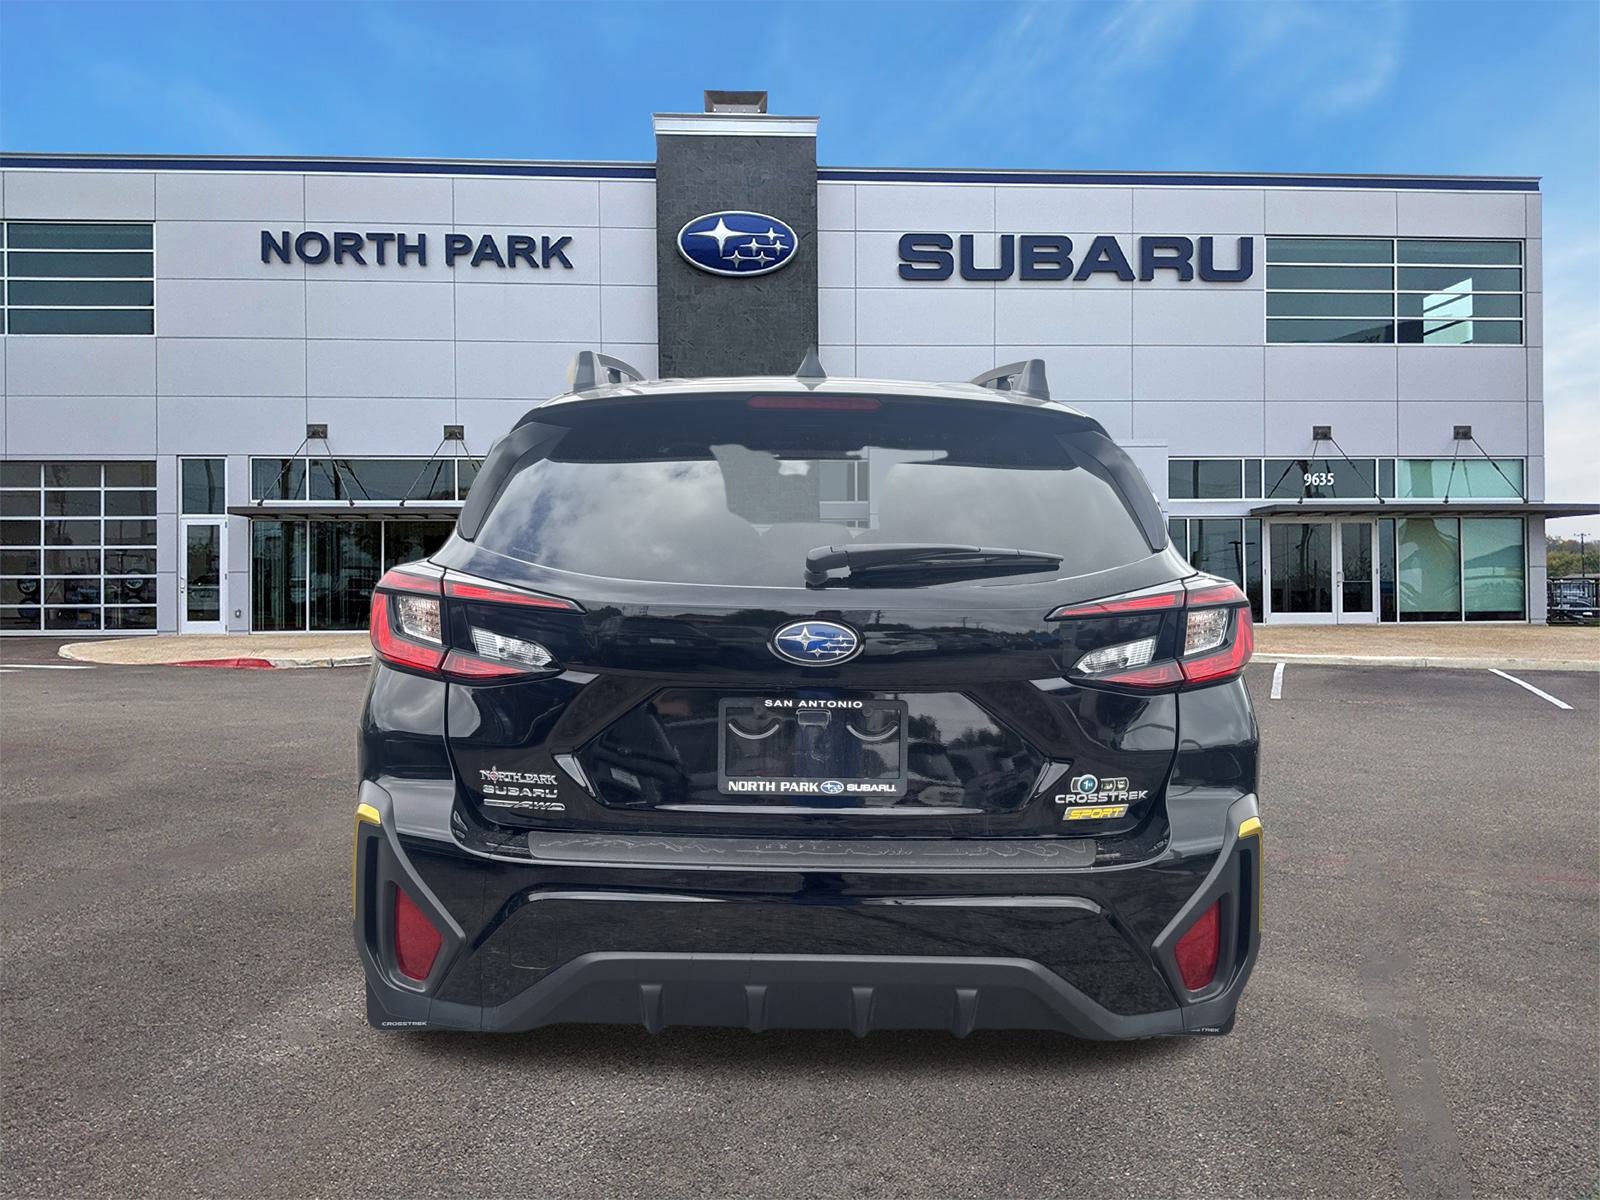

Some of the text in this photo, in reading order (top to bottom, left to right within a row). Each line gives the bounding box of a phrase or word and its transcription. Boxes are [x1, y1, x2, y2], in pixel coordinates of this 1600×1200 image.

[260, 230, 574, 269] NORTH PARK
[898, 233, 1254, 282] SUBARU
[1303, 472, 1335, 486] 9635
[764, 699, 863, 709] SAN ANTONIO
[523, 773, 558, 785] PARK
[482, 784, 558, 798] SUBARU
[728, 781, 776, 792] NORTH
[780, 782, 819, 793] PARK
[1055, 790, 1149, 804] CROSSTREK
[1068, 807, 1124, 819] SPORT
